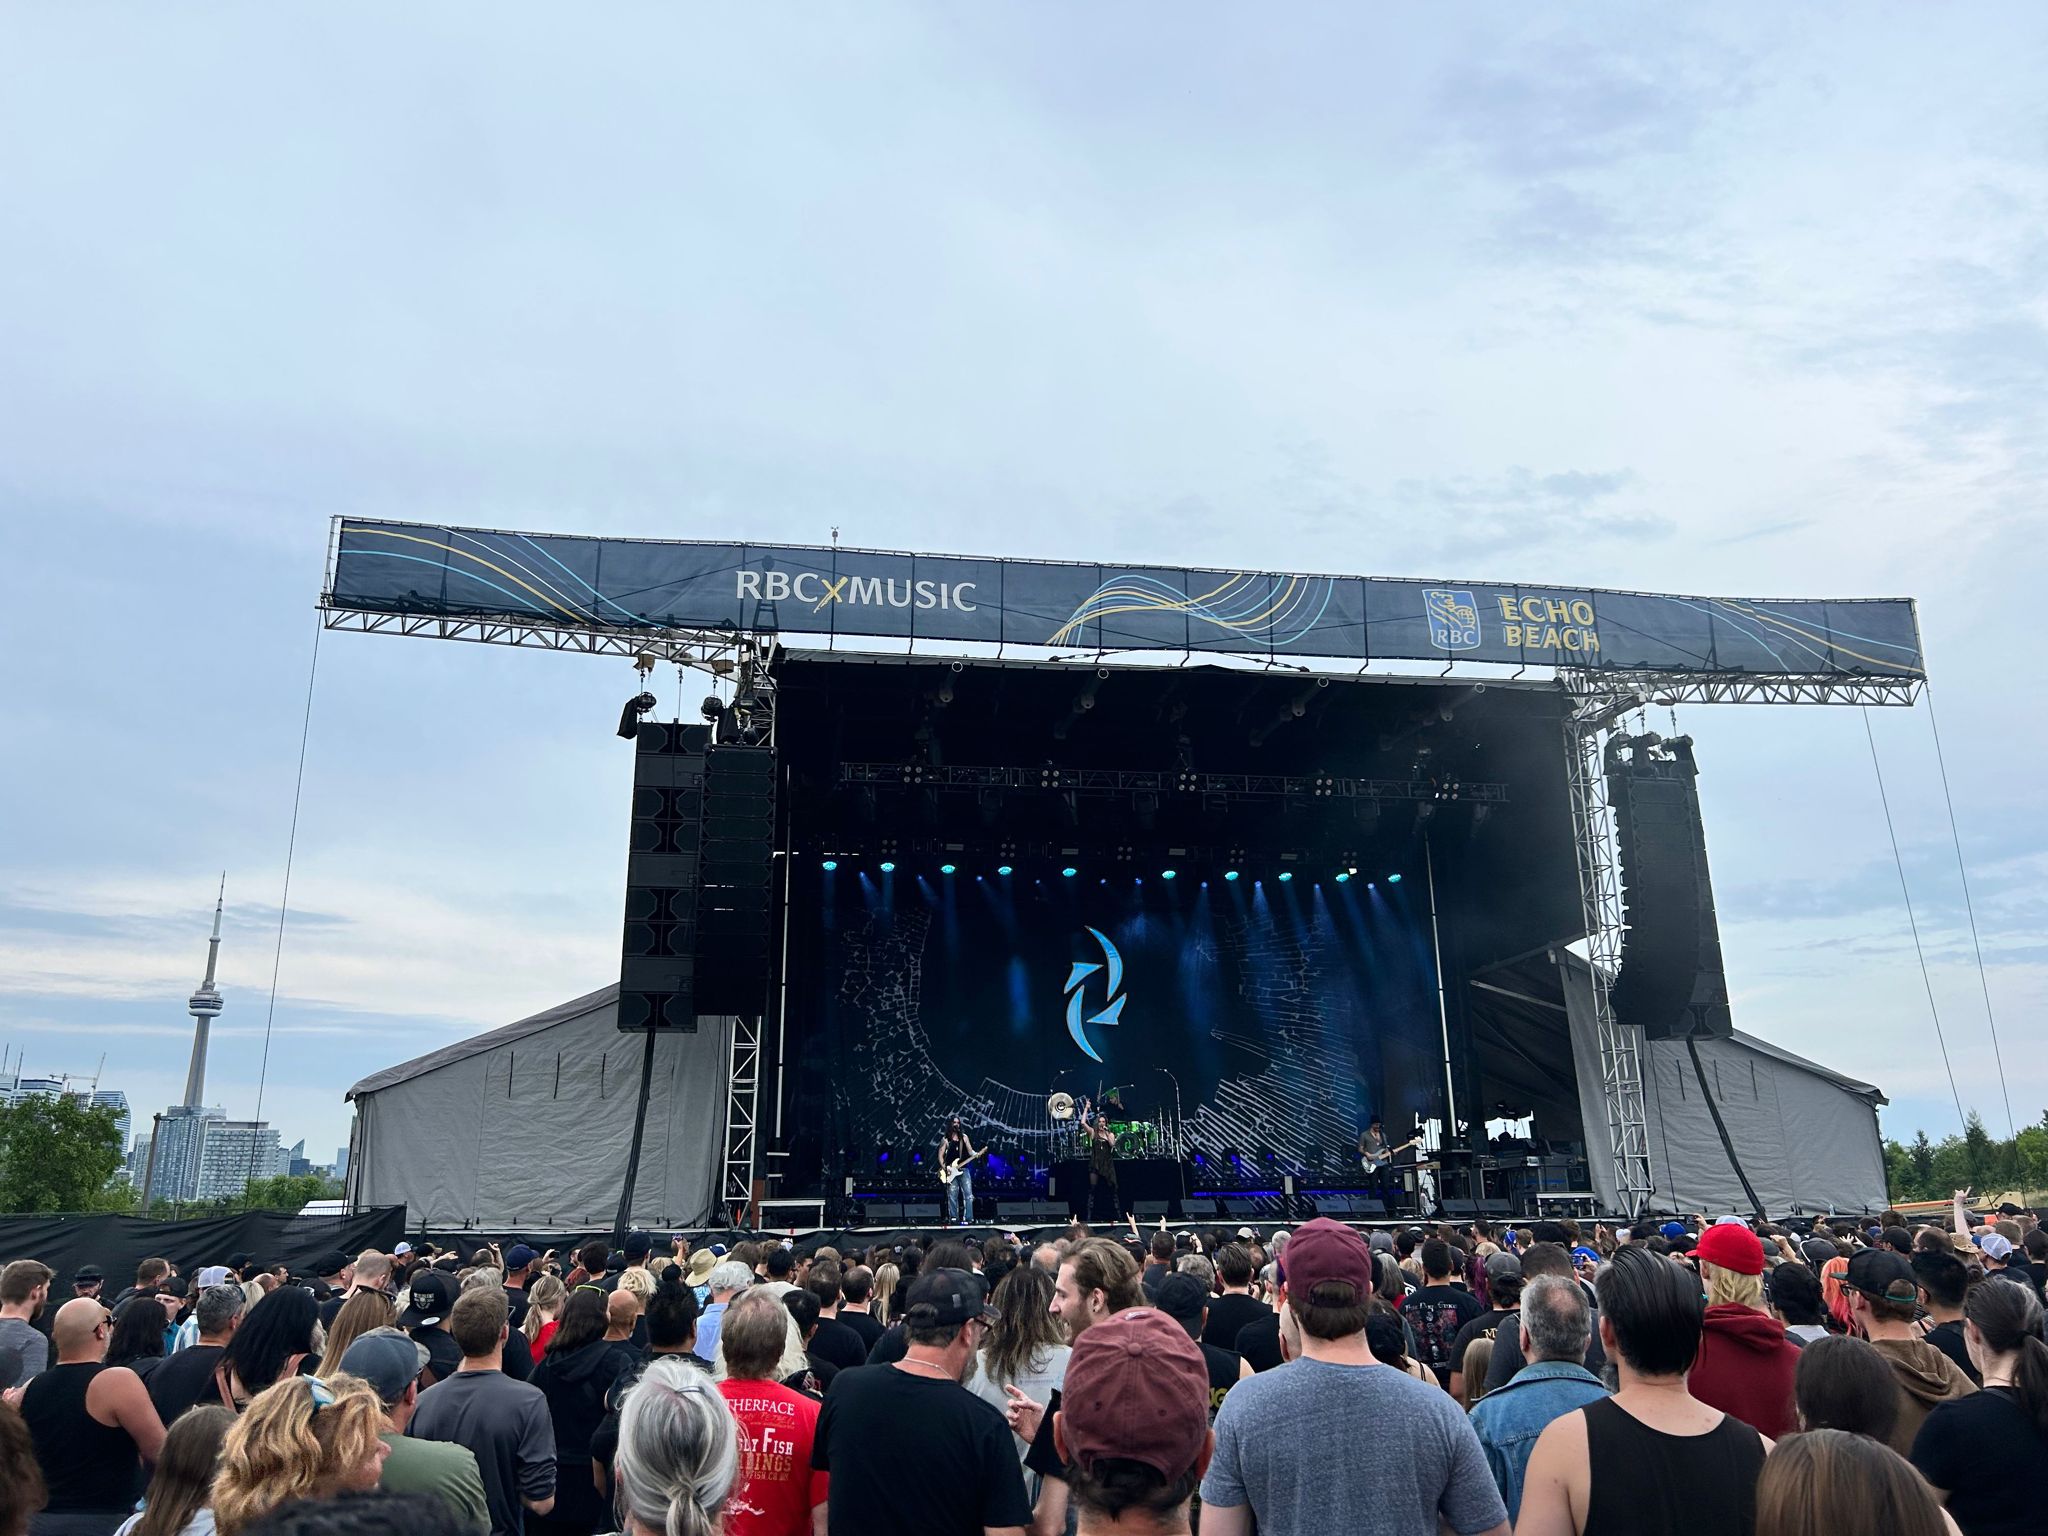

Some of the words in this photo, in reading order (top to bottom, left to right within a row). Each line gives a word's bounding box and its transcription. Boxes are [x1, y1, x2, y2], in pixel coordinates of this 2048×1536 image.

[1495, 595, 1595, 625] ECHO
[1437, 629, 1476, 645] RBC
[1503, 623, 1600, 652] BEACH
[726, 1398, 795, 1416] THERFACE
[738, 1438, 760, 1453] GLY
[763, 1427, 794, 1456] FISH
